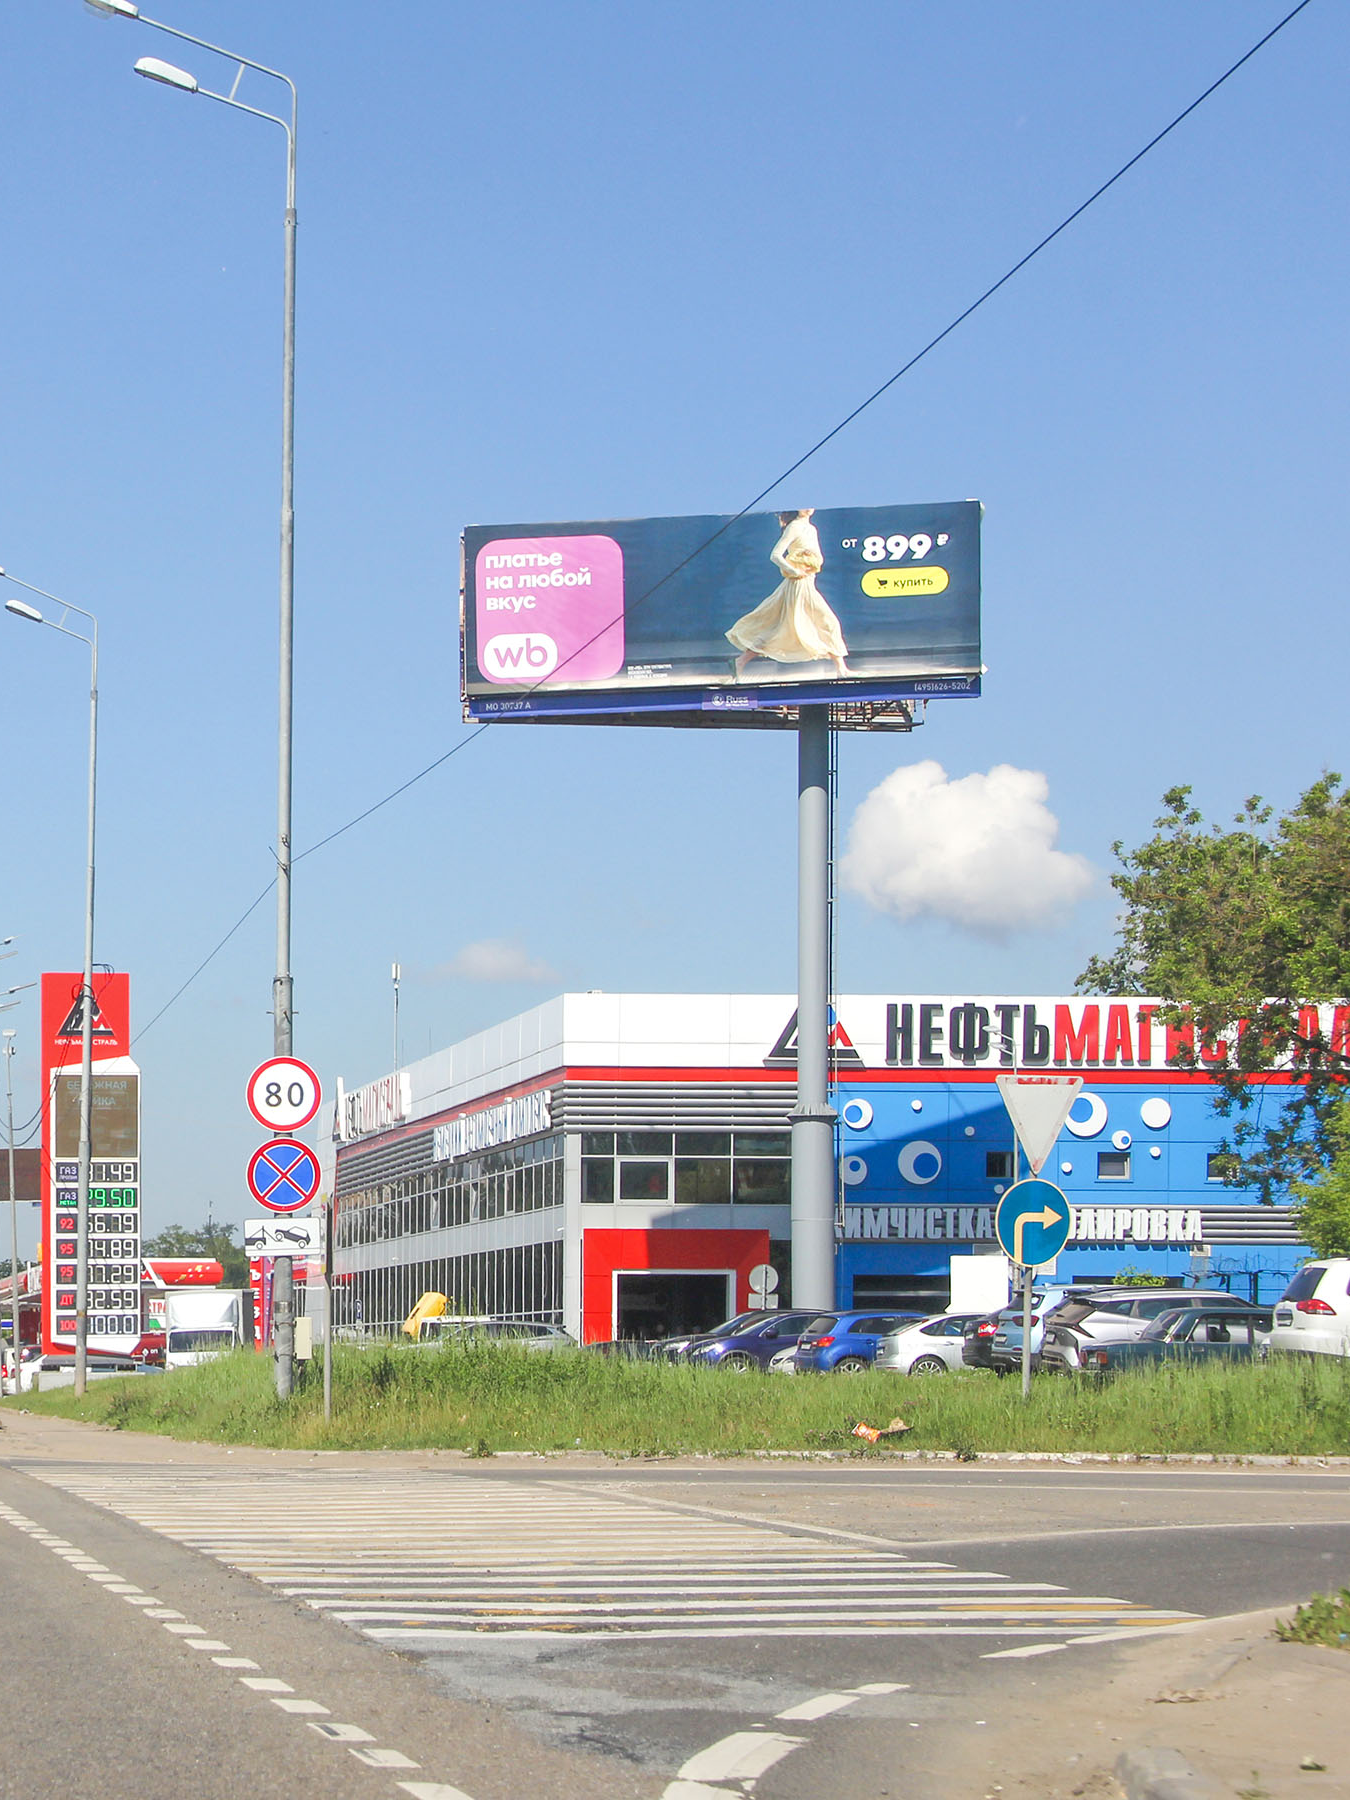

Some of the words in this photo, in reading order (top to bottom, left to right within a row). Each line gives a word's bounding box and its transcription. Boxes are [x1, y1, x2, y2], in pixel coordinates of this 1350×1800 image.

[841, 538, 858, 549] от
[862, 533, 932, 562] 899
[485, 552, 563, 569] платье
[485, 575, 513, 590] на
[518, 567, 591, 589] любой
[893, 577, 934, 590] купить
[486, 595, 537, 614] вкус
[493, 637, 548, 668] wb
[265, 1082, 304, 1107] 80
[59, 1166, 77, 1175] ГАЗ
[59, 1192, 77, 1200] ГАЗ
[59, 1217, 75, 1230] 92
[59, 1242, 75, 1255] 95
[60, 1265, 74, 1277] 95
[59, 1294, 74, 1306] ДТ
[59, 1319, 77, 1332] 100
